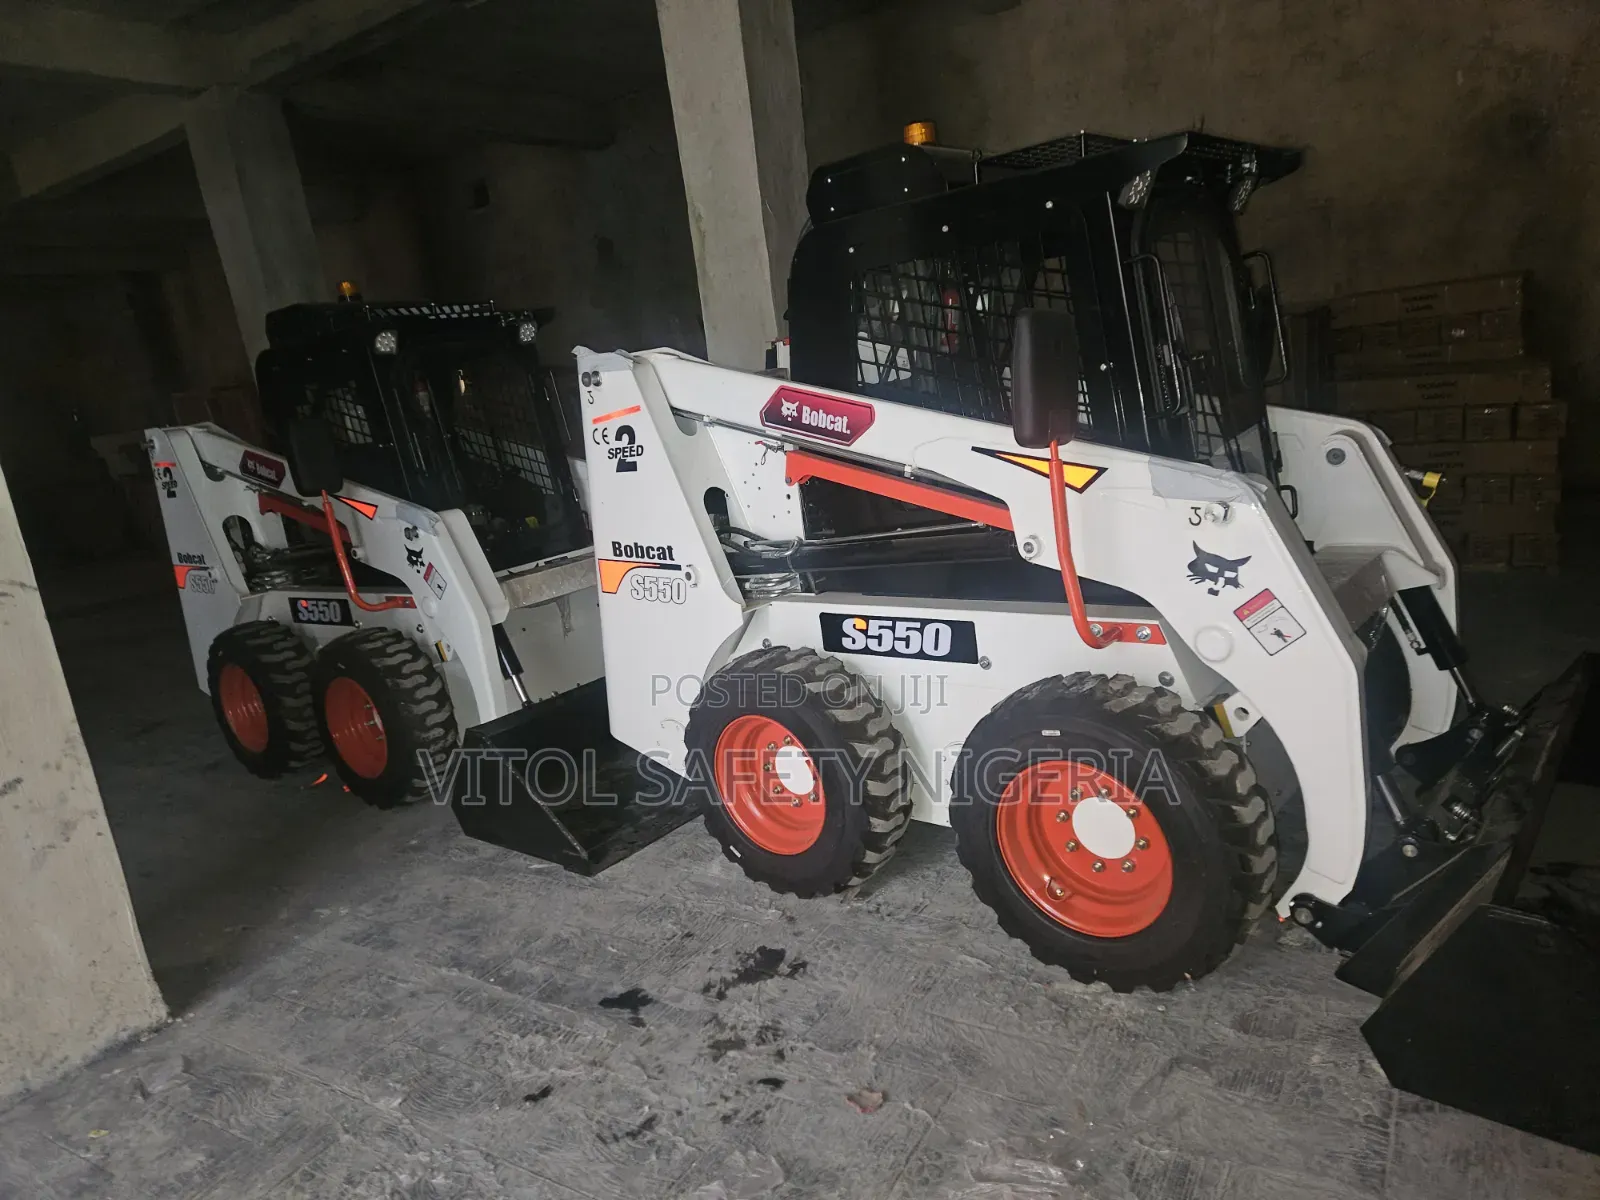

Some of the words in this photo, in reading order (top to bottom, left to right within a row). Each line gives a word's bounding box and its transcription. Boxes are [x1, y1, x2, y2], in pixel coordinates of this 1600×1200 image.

[607, 444, 645, 460] SPEED
[176, 552, 207, 565] Bobcat
[611, 541, 676, 561] Bobcat
[630, 574, 687, 605] S550
[296, 599, 342, 623] S550
[840, 616, 954, 659] S550
